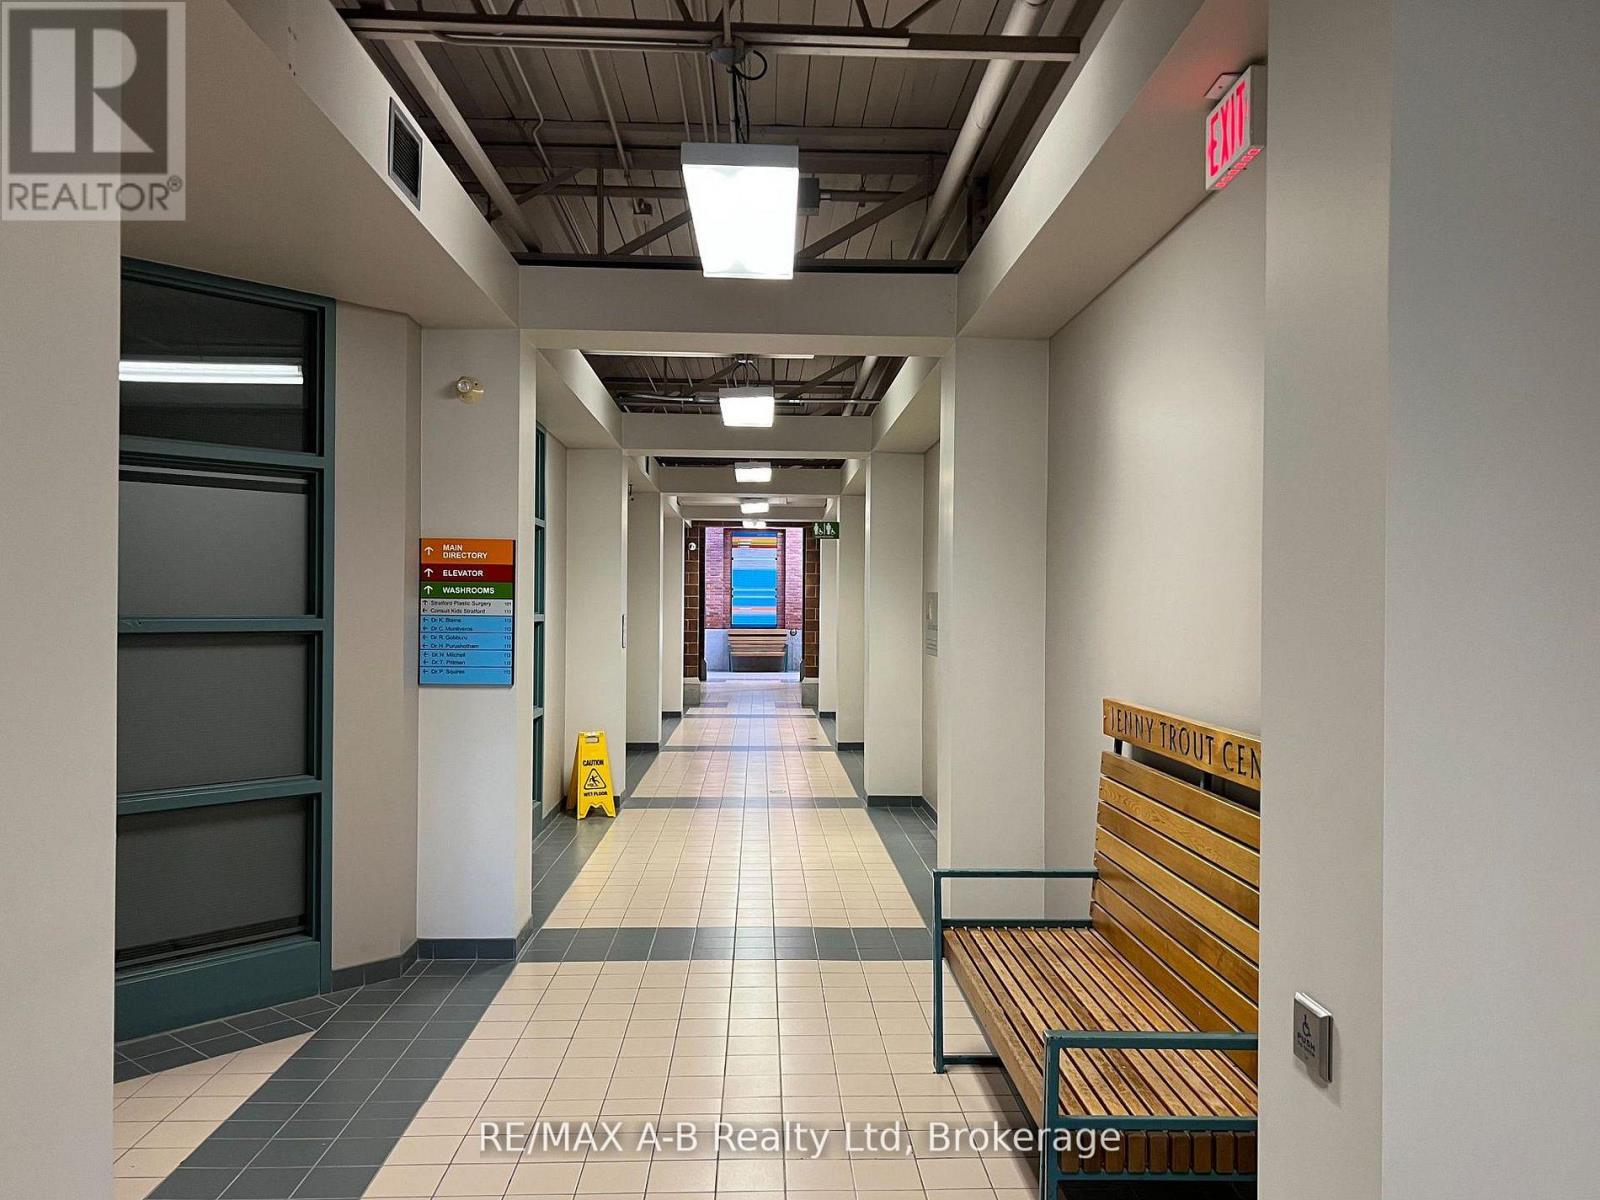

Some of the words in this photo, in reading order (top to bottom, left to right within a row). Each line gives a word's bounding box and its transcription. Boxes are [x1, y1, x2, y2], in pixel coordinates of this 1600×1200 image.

[1208, 80, 1245, 176] EXIT
[442, 569, 484, 577] ELEVATOR
[442, 586, 495, 594] WASHROOMS
[1110, 706, 1154, 743] JENNY
[1160, 721, 1215, 765] TROUT
